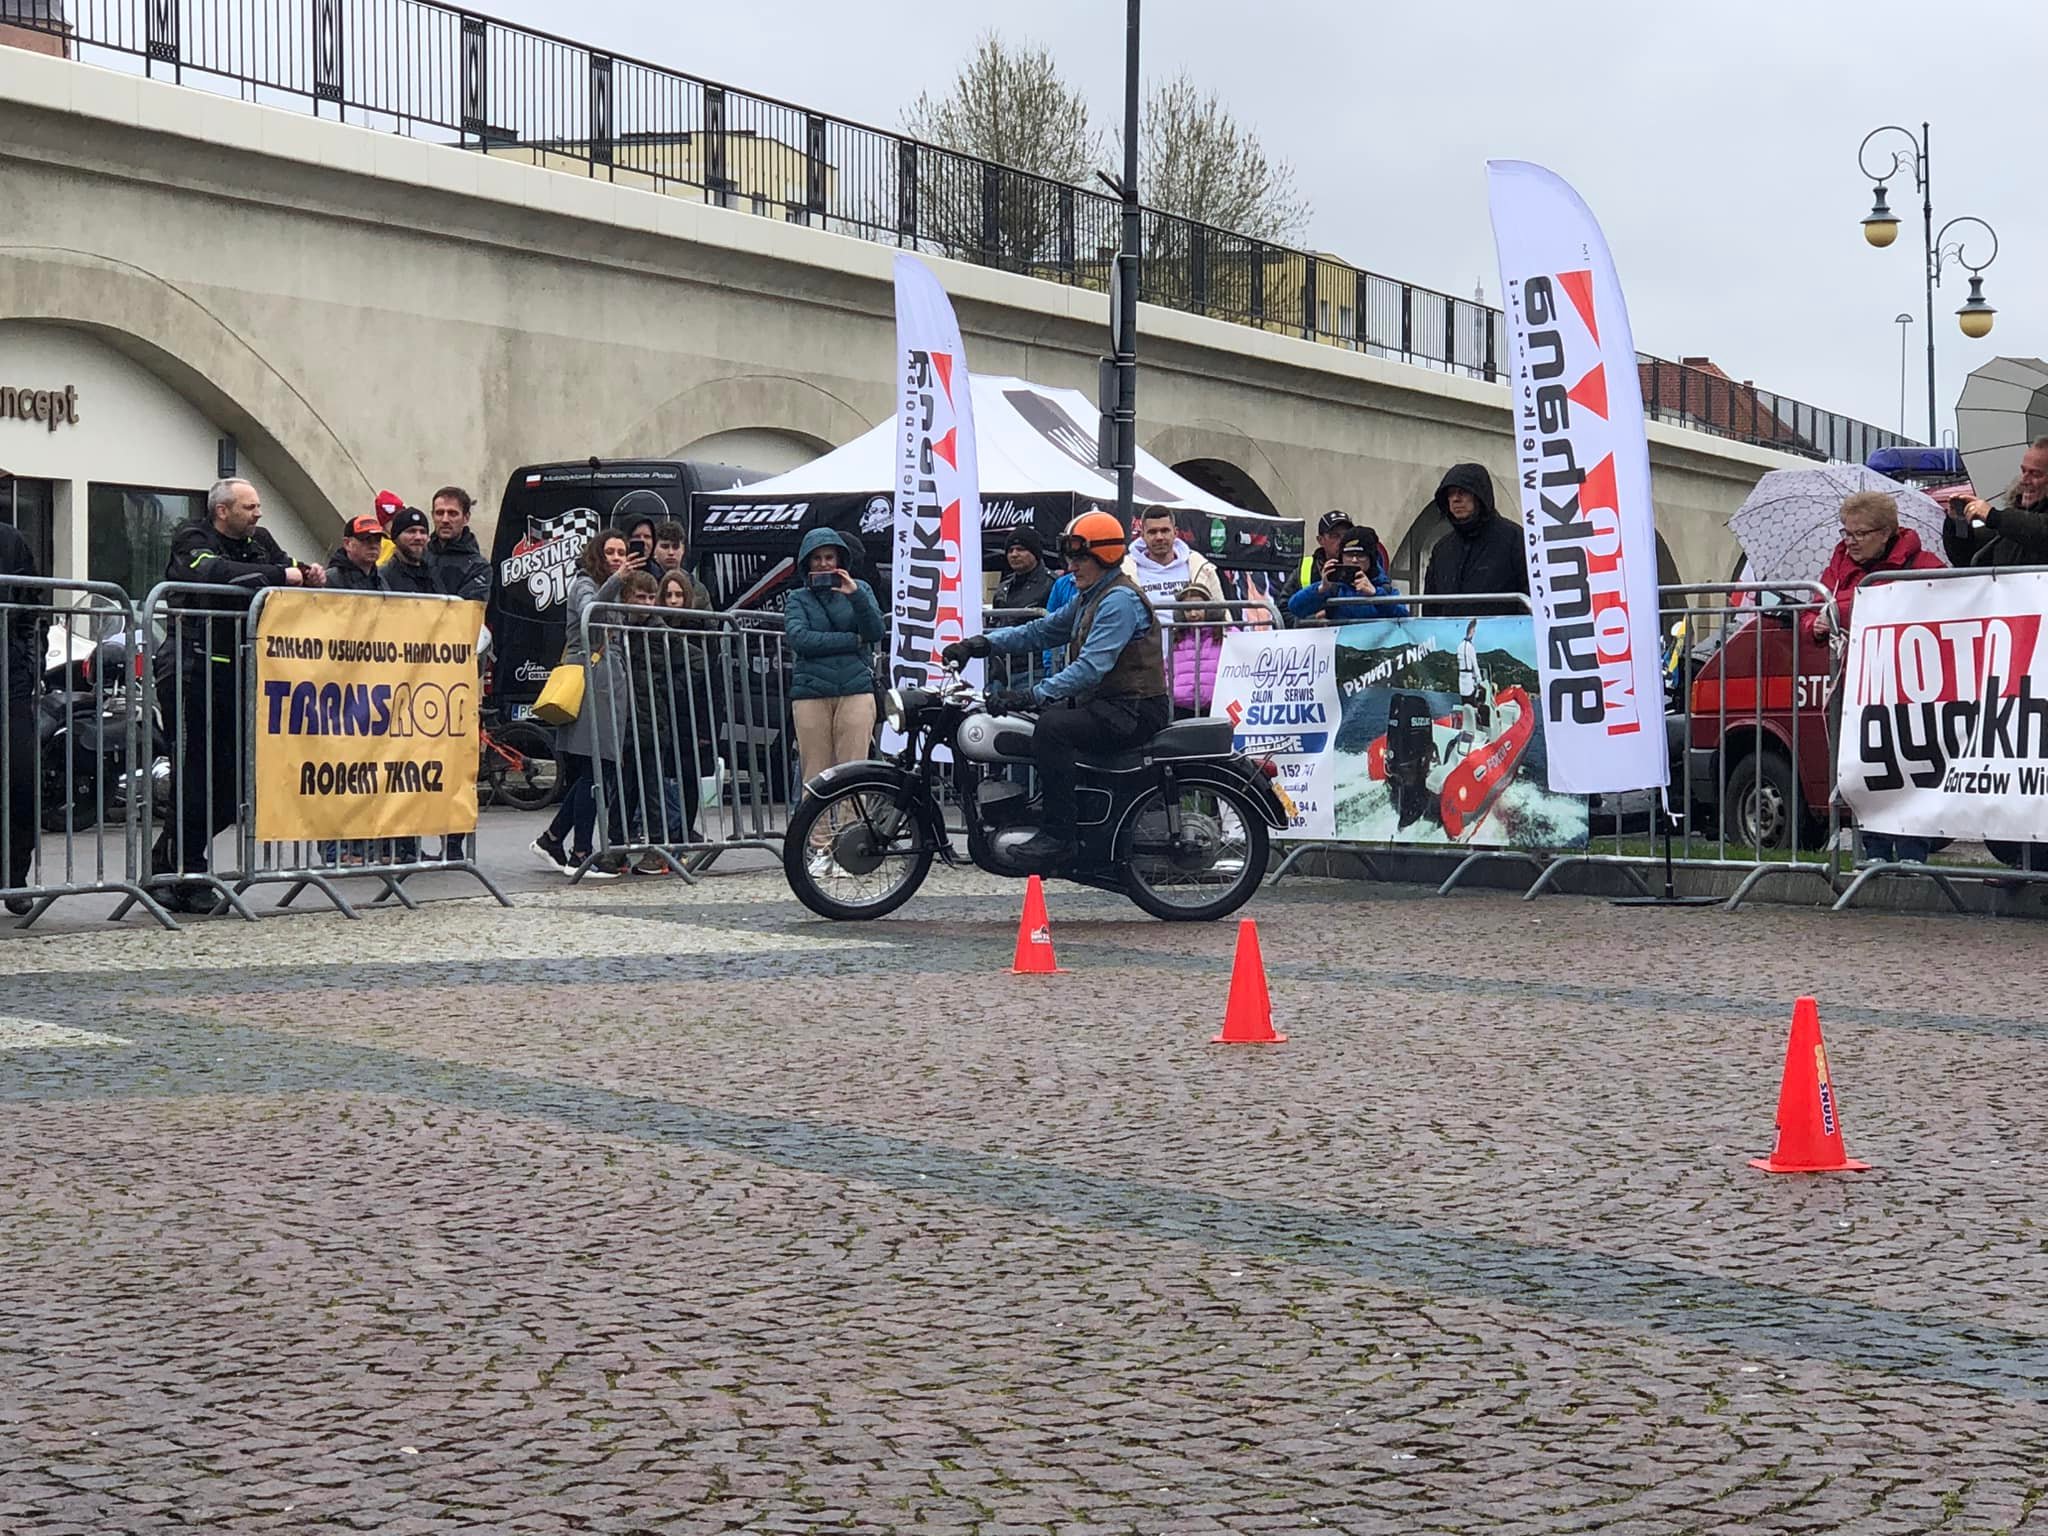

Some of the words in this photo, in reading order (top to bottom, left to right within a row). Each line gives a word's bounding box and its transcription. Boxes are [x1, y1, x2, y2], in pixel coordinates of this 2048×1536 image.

[0, 384, 80, 432] ncept
[704, 503, 810, 524] TEMA
[501, 535, 582, 586] FORSTNER
[266, 635, 324, 661] ZAKŁAD
[1861, 618, 2013, 706] MOTO
[1342, 659, 1394, 698] PŁYWAJ
[1395, 653, 1405, 671] Z
[1250, 689, 1274, 704] SALON
[1284, 687, 1315, 702] SERWIS
[1245, 703, 1327, 726] SUZUKI
[299, 760, 379, 796] ROBERT
[384, 759, 444, 793] TKACZ
[1280, 763, 1301, 778] 152
[2018, 766, 2048, 796] Wi
[1289, 816, 1308, 828] LKP.
